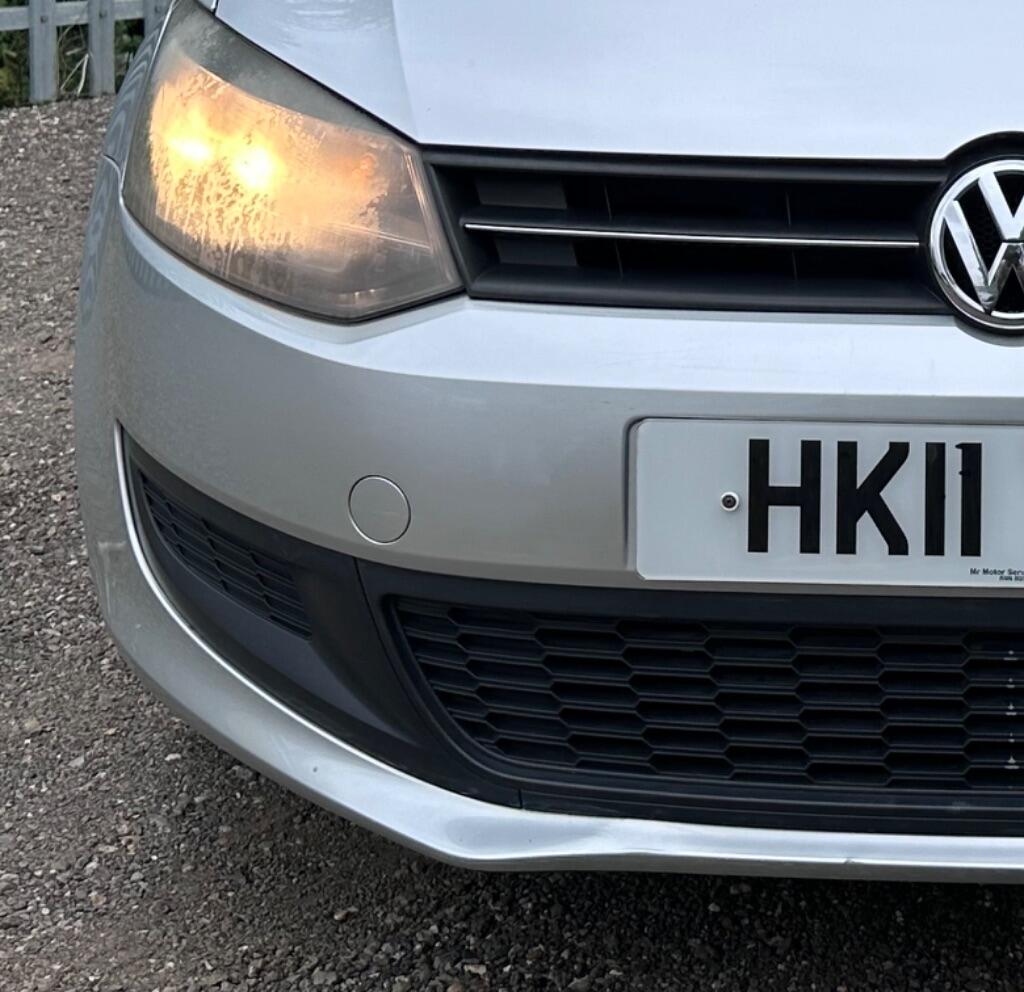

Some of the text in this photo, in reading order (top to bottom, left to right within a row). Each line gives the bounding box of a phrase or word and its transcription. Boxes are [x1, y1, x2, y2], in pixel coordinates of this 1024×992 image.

[747, 438, 983, 557] HK11
[969, 567, 980, 576] Mr
[982, 567, 1006, 576] Motor
